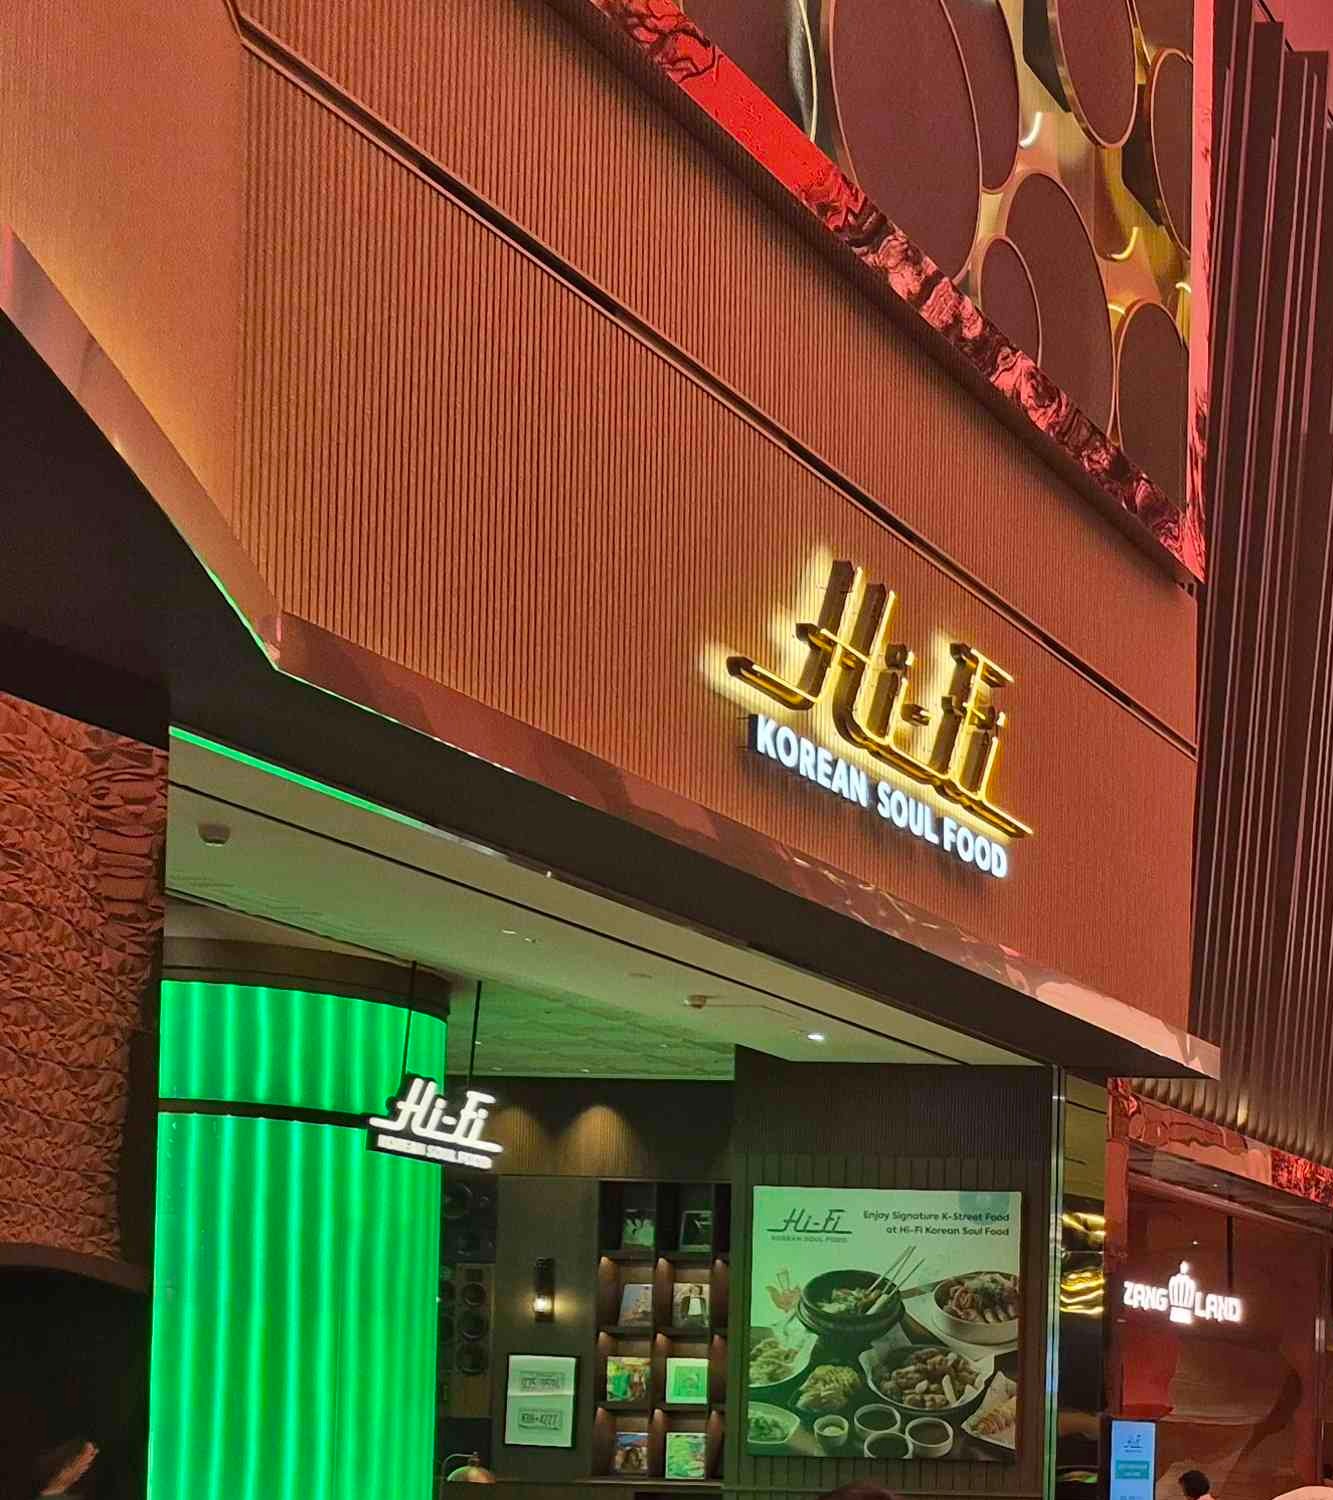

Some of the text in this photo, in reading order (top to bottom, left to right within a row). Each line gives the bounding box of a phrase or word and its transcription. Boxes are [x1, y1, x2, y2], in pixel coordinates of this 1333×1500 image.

[726, 559, 1034, 838] Hi-Fi
[755, 714, 1009, 879] KOREAN SOUL FOOD
[369, 1078, 503, 1153] Hi-Fi
[766, 1208, 853, 1234] Hi-Fi
[863, 1210, 1010, 1222] Enjoy Signature K-Street Food
[886, 1226, 896, 1234] at
[925, 1226, 960, 1235] Korean
[962, 1227, 982, 1236] Soul
[985, 1227, 1009, 1236] Food
[1123, 1281, 1242, 1322] ZANG LAND
